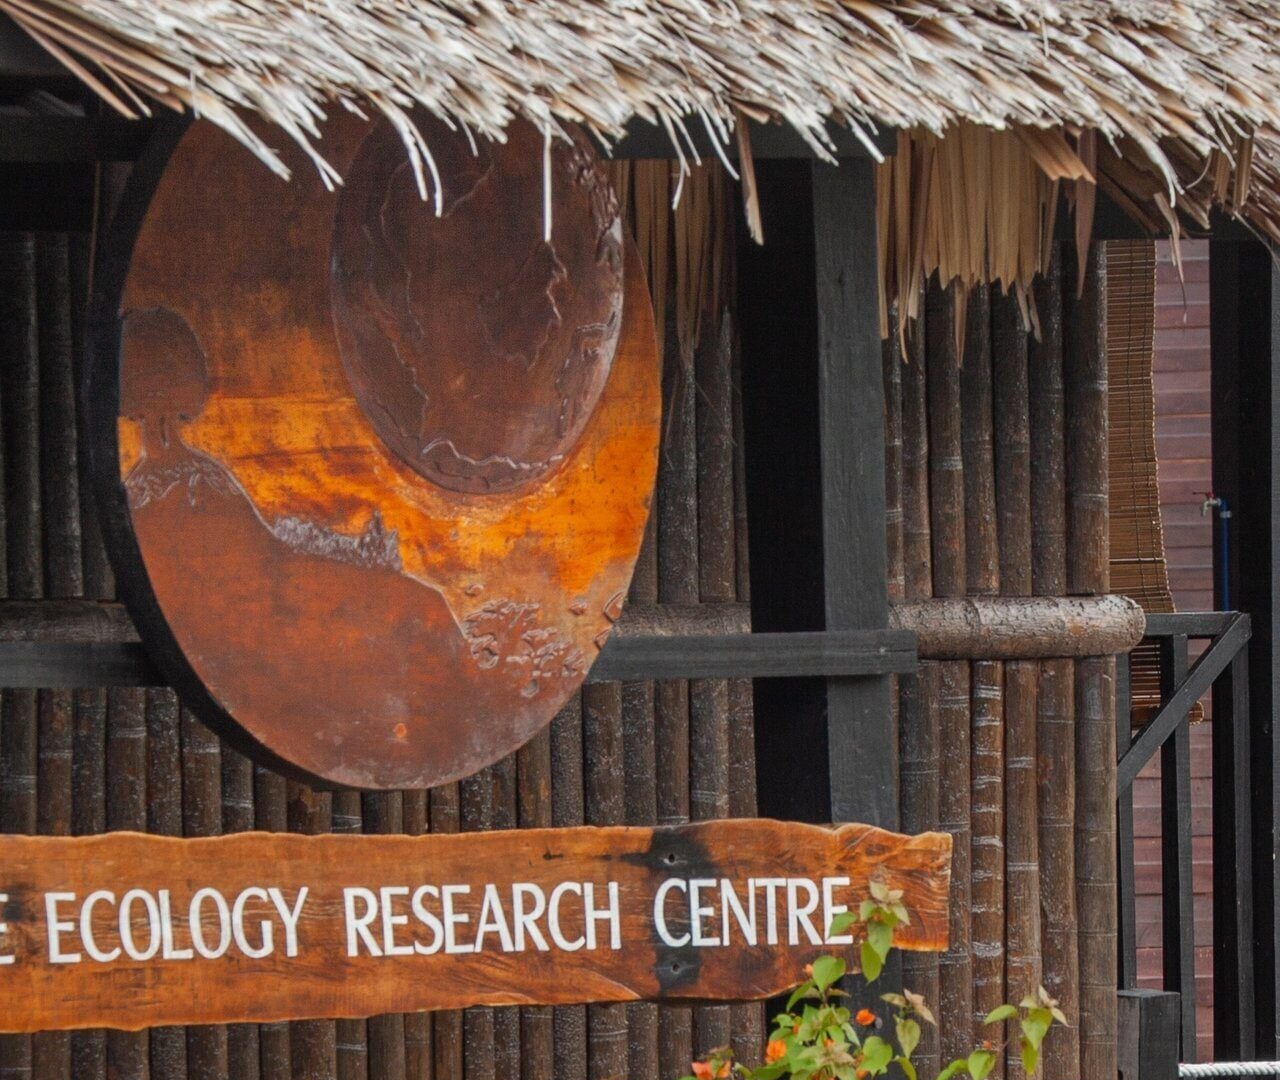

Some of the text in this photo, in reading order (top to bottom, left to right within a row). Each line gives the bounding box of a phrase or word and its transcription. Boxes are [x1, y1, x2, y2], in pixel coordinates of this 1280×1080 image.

[43, 885, 310, 964] ECOLOGY
[343, 880, 622, 957] RESEARCH
[652, 876, 855, 948] CENTRE
